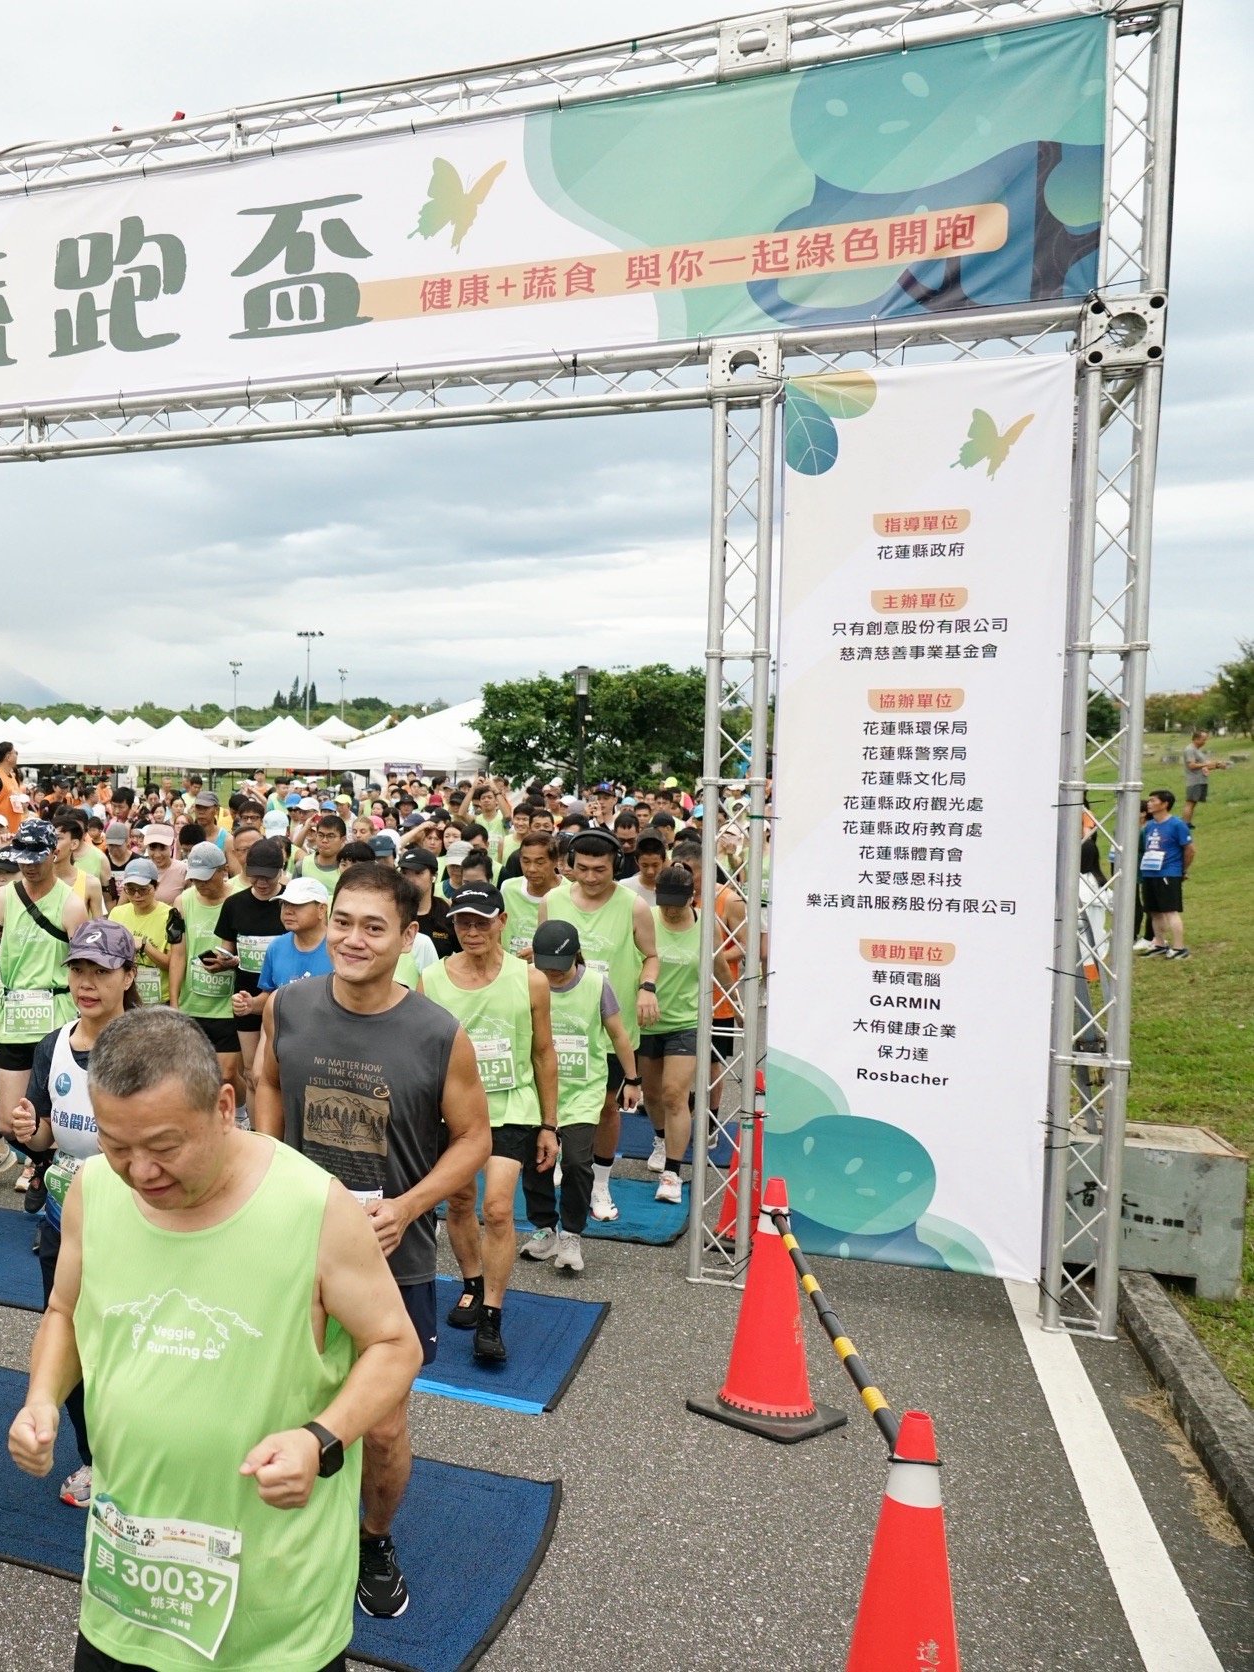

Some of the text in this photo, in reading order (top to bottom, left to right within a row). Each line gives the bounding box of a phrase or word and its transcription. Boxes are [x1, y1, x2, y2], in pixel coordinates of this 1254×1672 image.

[419, 212, 975, 311] 健康+蔬食 與你一起綠色開跑
[884, 514, 959, 533] 指導單位
[877, 542, 965, 560] 花蓮縣政府
[883, 592, 956, 610] 主辦單位
[832, 617, 1009, 637] 只有創意股份有限公司
[839, 643, 998, 662] 慈濟慈善事業基金會
[879, 693, 953, 709] 協辦單位
[862, 720, 968, 736] 花蓮縣環保局
[862, 746, 967, 761] 花蓮縣警察局
[861, 771, 966, 786] 花蓮縣文化局
[843, 795, 984, 812] 花蓮縣政府觀光處
[842, 820, 983, 837] 花蓮縣政府教育處
[858, 845, 964, 862] 花蓮縣體育會
[858, 870, 963, 887] 大愛感恩科技
[806, 893, 1017, 915] 樂活資訊服務股份有限公司
[871, 943, 944, 962] 贊助單位
[200, 974, 231, 986] 30084
[872, 970, 941, 987] 華碩電腦
[869, 994, 941, 1011] GARMIN
[15, 1007, 50, 1019] 30080
[852, 1019, 957, 1038] 大侑健康企業
[877, 1044, 929, 1062] 保力達
[313, 1056, 383, 1073] NO MATTER HOW
[327, 1066, 346, 1077] TIME
[313, 1076, 331, 1087] STILL
[333, 1079, 353, 1088] LOVE
[355, 1081, 372, 1091] YOU
[856, 1068, 949, 1087] Rosbacher
[51, 1107, 98, 1133] 太魯閣路
[152, 1324, 196, 1342] Veggie
[146, 1340, 201, 1360] Running
[96, 1543, 116, 1576] 男
[121, 1558, 228, 1608] 30037
